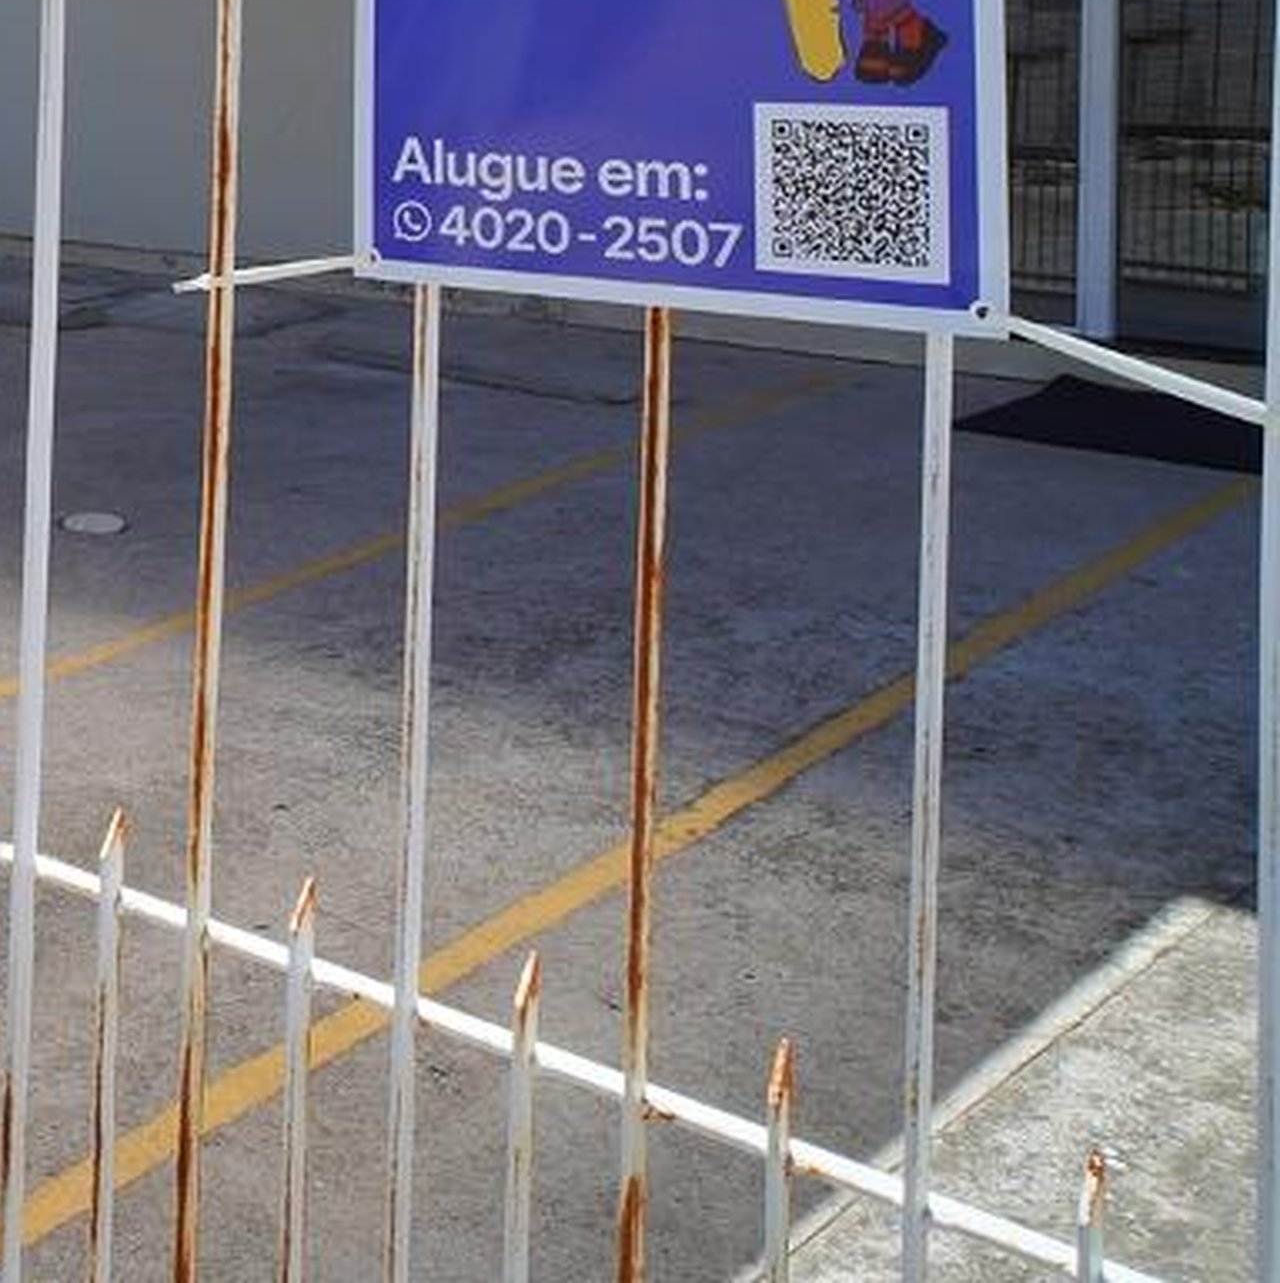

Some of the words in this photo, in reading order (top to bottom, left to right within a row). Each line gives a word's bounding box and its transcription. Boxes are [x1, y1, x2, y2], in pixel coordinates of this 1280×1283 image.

[391, 136, 586, 201] Alugue
[597, 157, 709, 201] em:
[439, 205, 743, 268] 4020-2507
